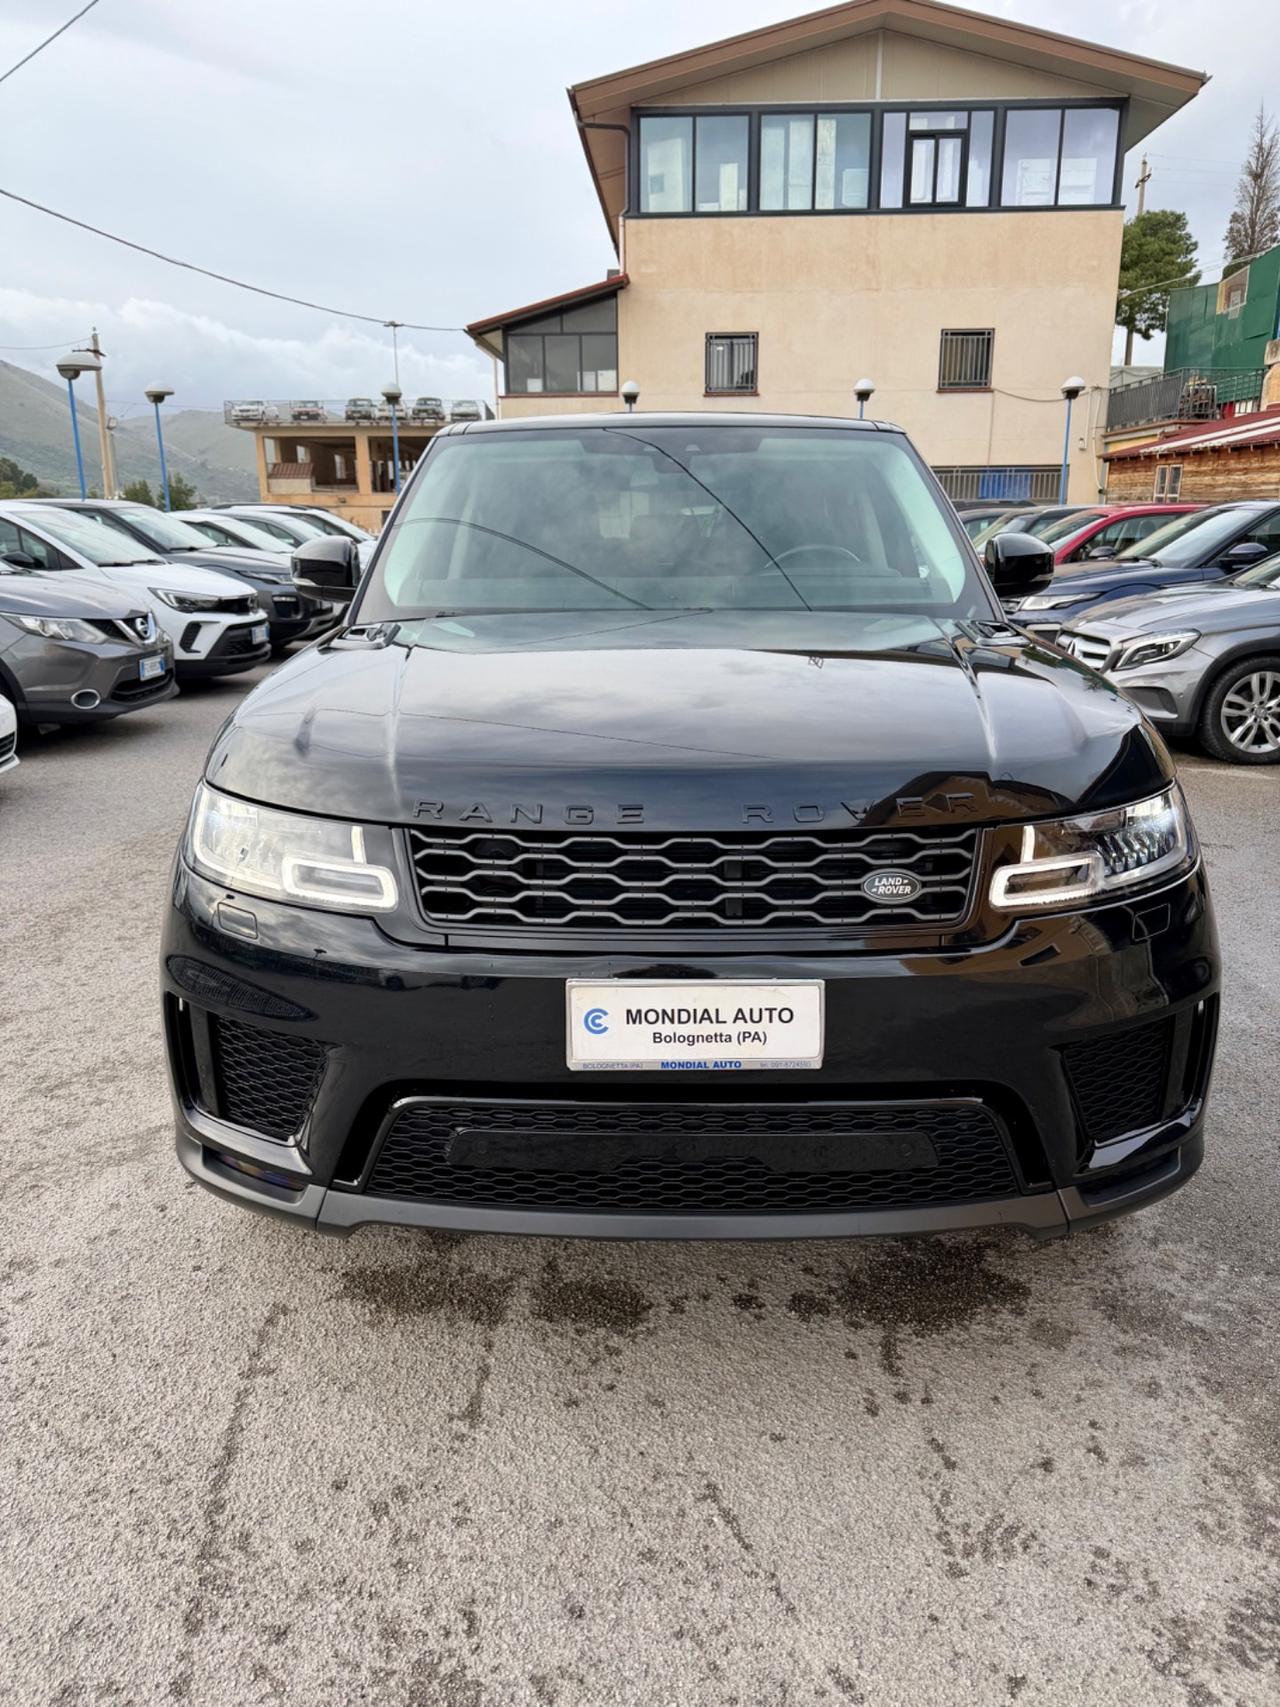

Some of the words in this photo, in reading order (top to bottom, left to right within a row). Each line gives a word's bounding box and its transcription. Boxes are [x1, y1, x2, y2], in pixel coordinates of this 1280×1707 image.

[413, 801, 644, 825] RANGE
[742, 792, 978, 824] ROVER
[875, 877, 902, 886] LAND
[878, 885, 912, 894] ROVER
[625, 1008, 727, 1025] MONDIAL
[732, 1007, 794, 1024] AUTO
[652, 1031, 732, 1047] Bolognetta
[737, 1031, 767, 1046] (PA)
[582, 1062, 628, 1070] BOLOGNETTA
[660, 1061, 709, 1070] MONDIAL
[712, 1060, 742, 1069] AUTO
